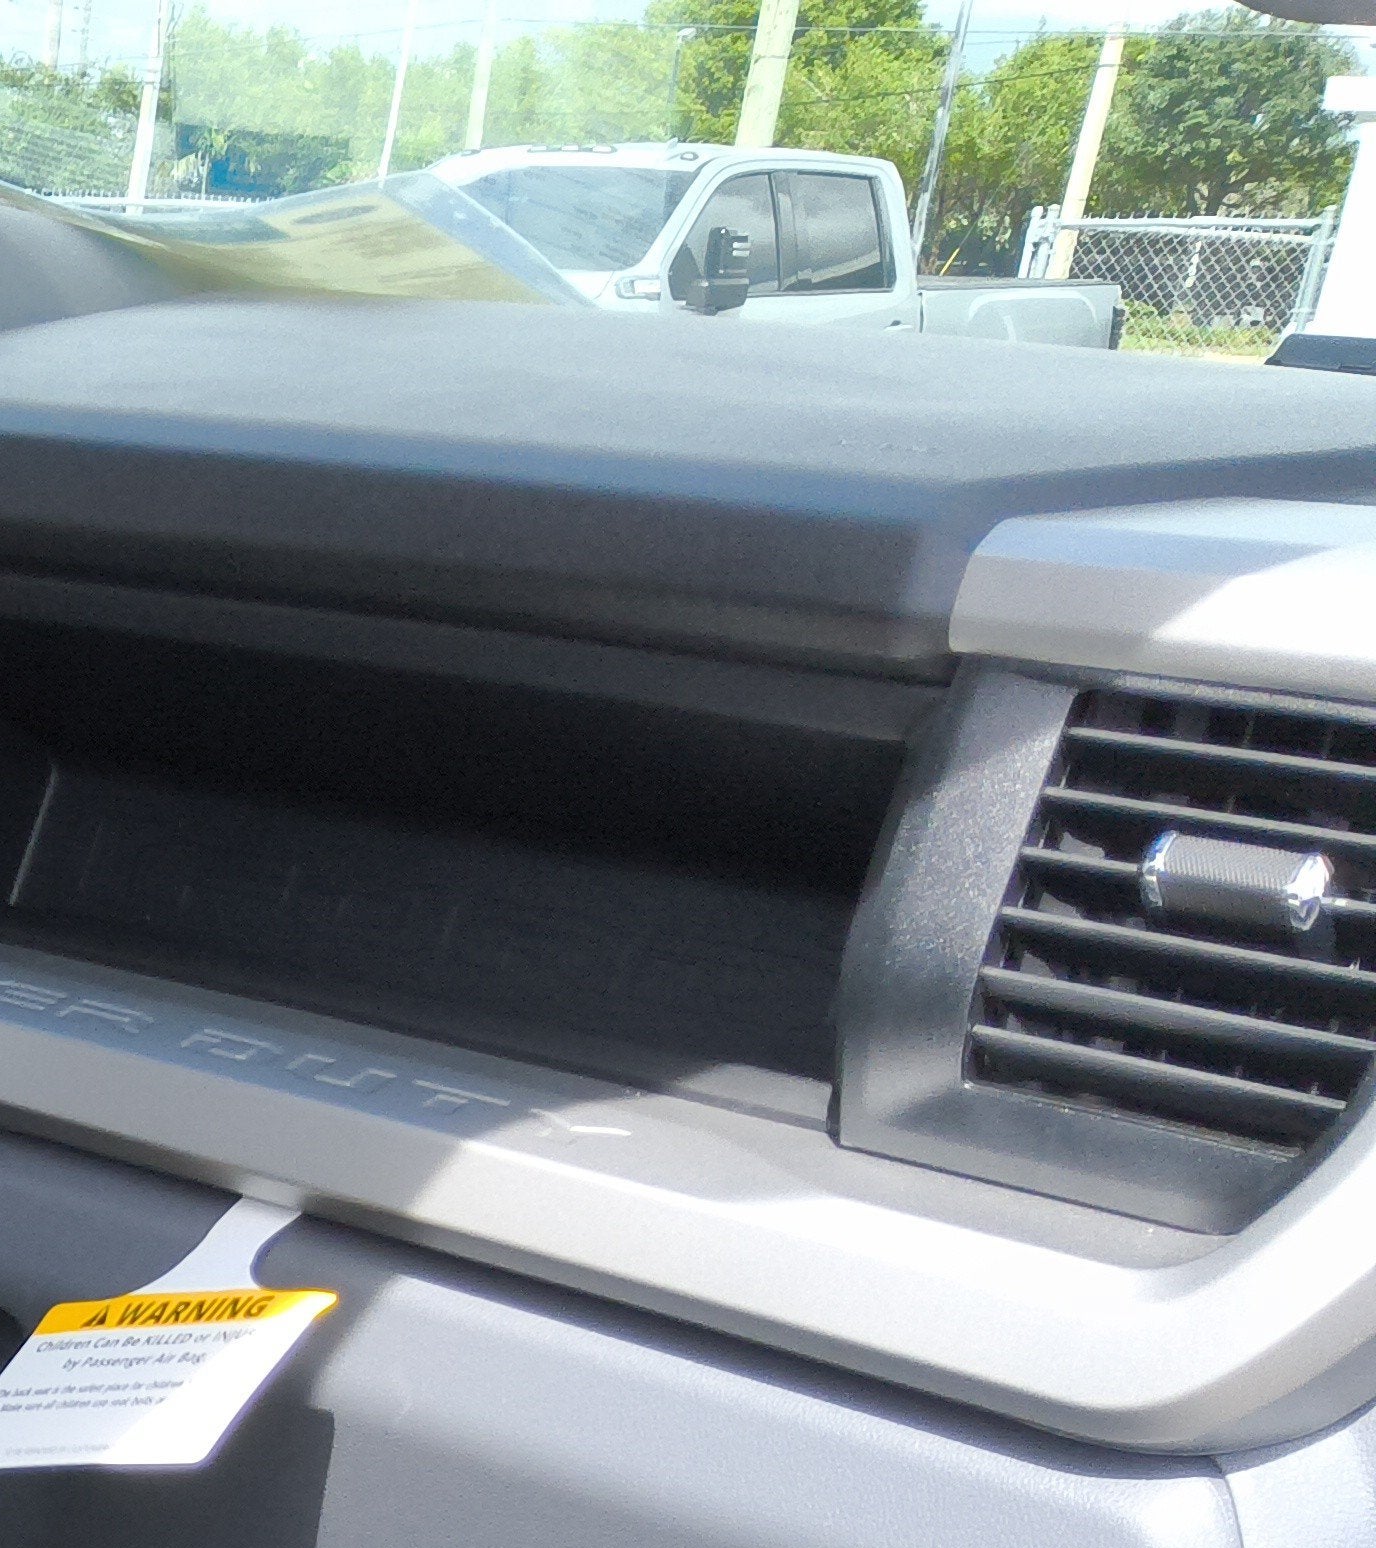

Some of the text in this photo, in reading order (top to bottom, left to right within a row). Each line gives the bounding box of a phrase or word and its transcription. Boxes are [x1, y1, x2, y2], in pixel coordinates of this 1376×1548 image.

[179, 1027, 634, 1139] DUTY
[116, 1295, 276, 1327] WARNING
[36, 1339, 92, 1353] Children
[93, 1336, 120, 1349] Can
[121, 1335, 141, 1348] Be
[142, 1333, 193, 1346] KILLED
[193, 1333, 211, 1344] or
[62, 1358, 82, 1372] by
[81, 1354, 152, 1370] Passenger
[153, 1352, 177, 1364] Air
